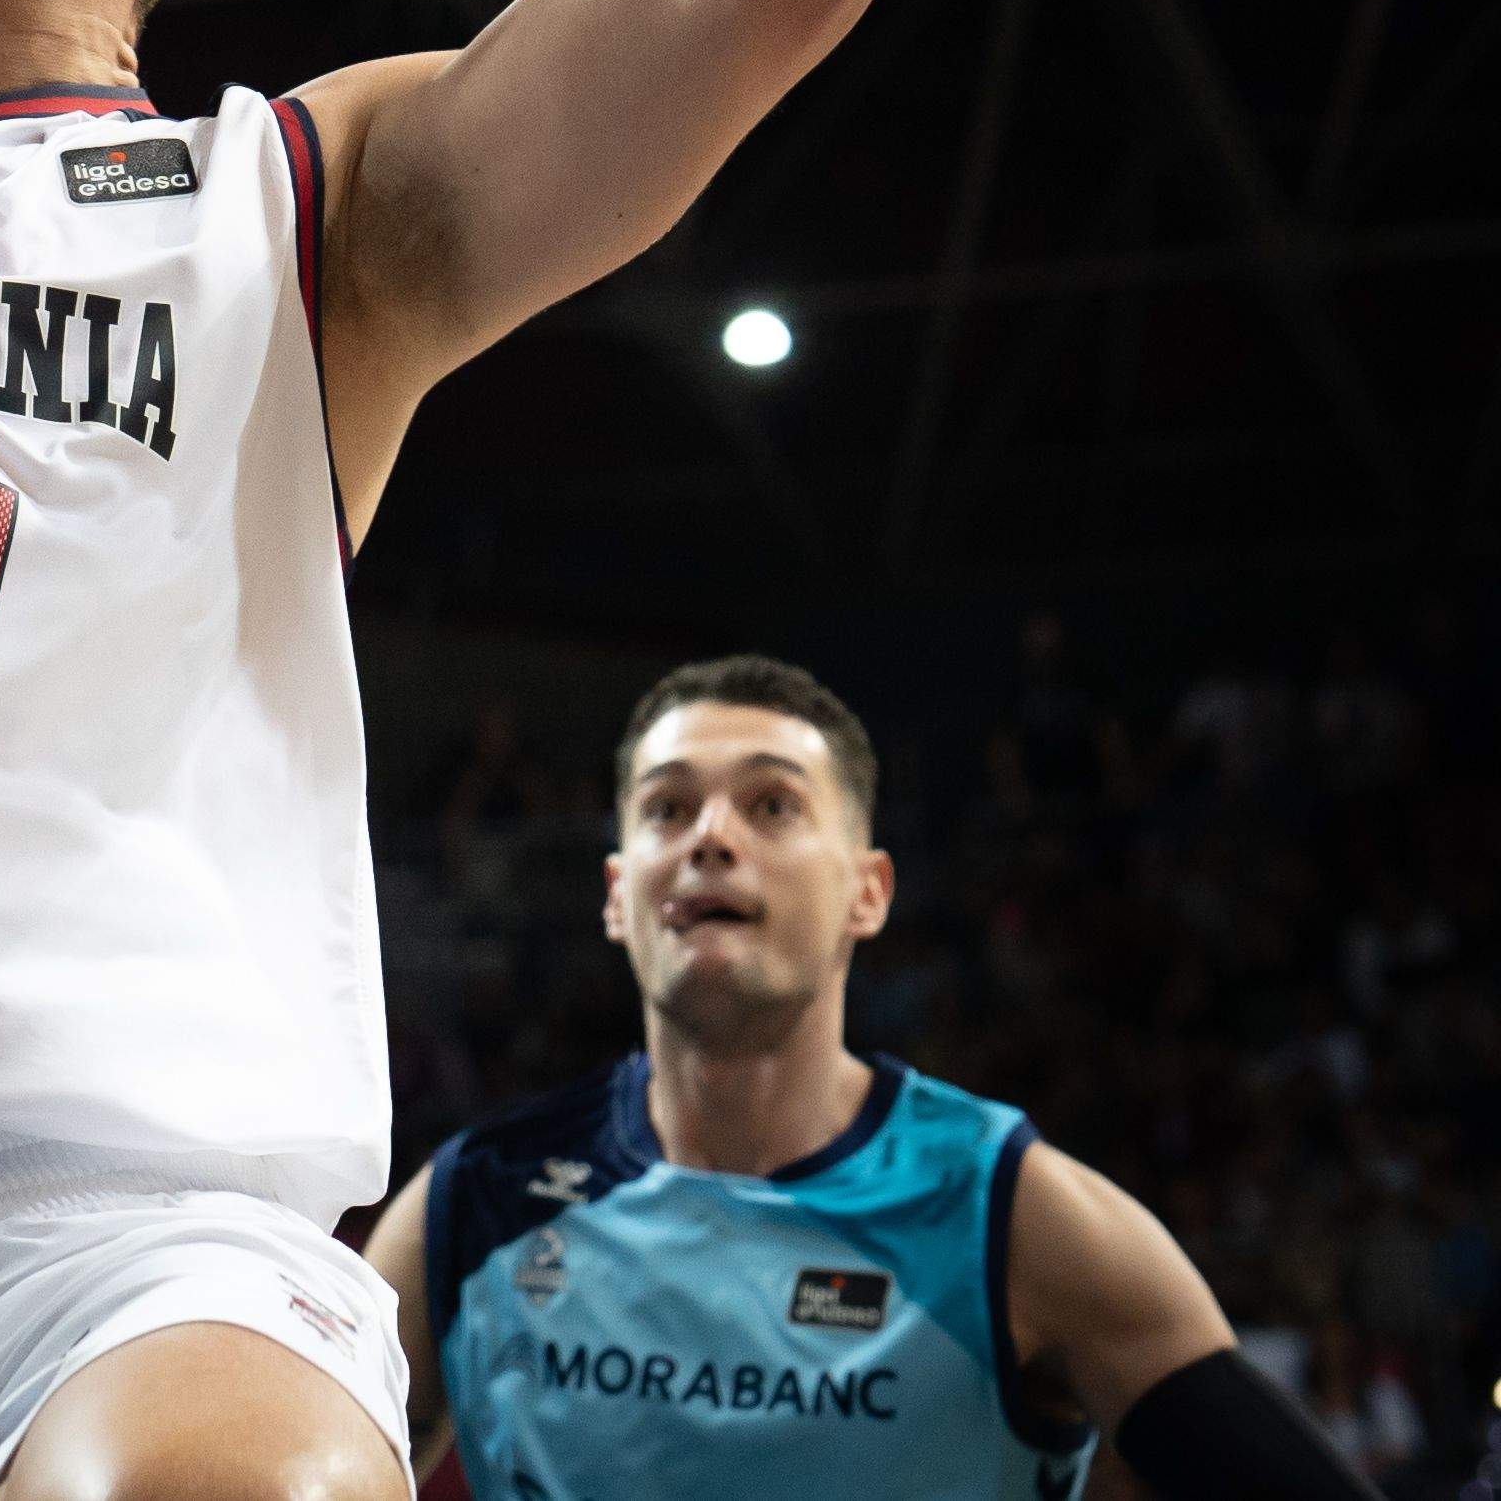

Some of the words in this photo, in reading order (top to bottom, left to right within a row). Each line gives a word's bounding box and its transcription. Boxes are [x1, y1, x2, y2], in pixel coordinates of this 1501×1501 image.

[73, 163, 125, 182] liga
[78, 173, 190, 197] endesa
[543, 1342, 897, 1419] MORABANC
